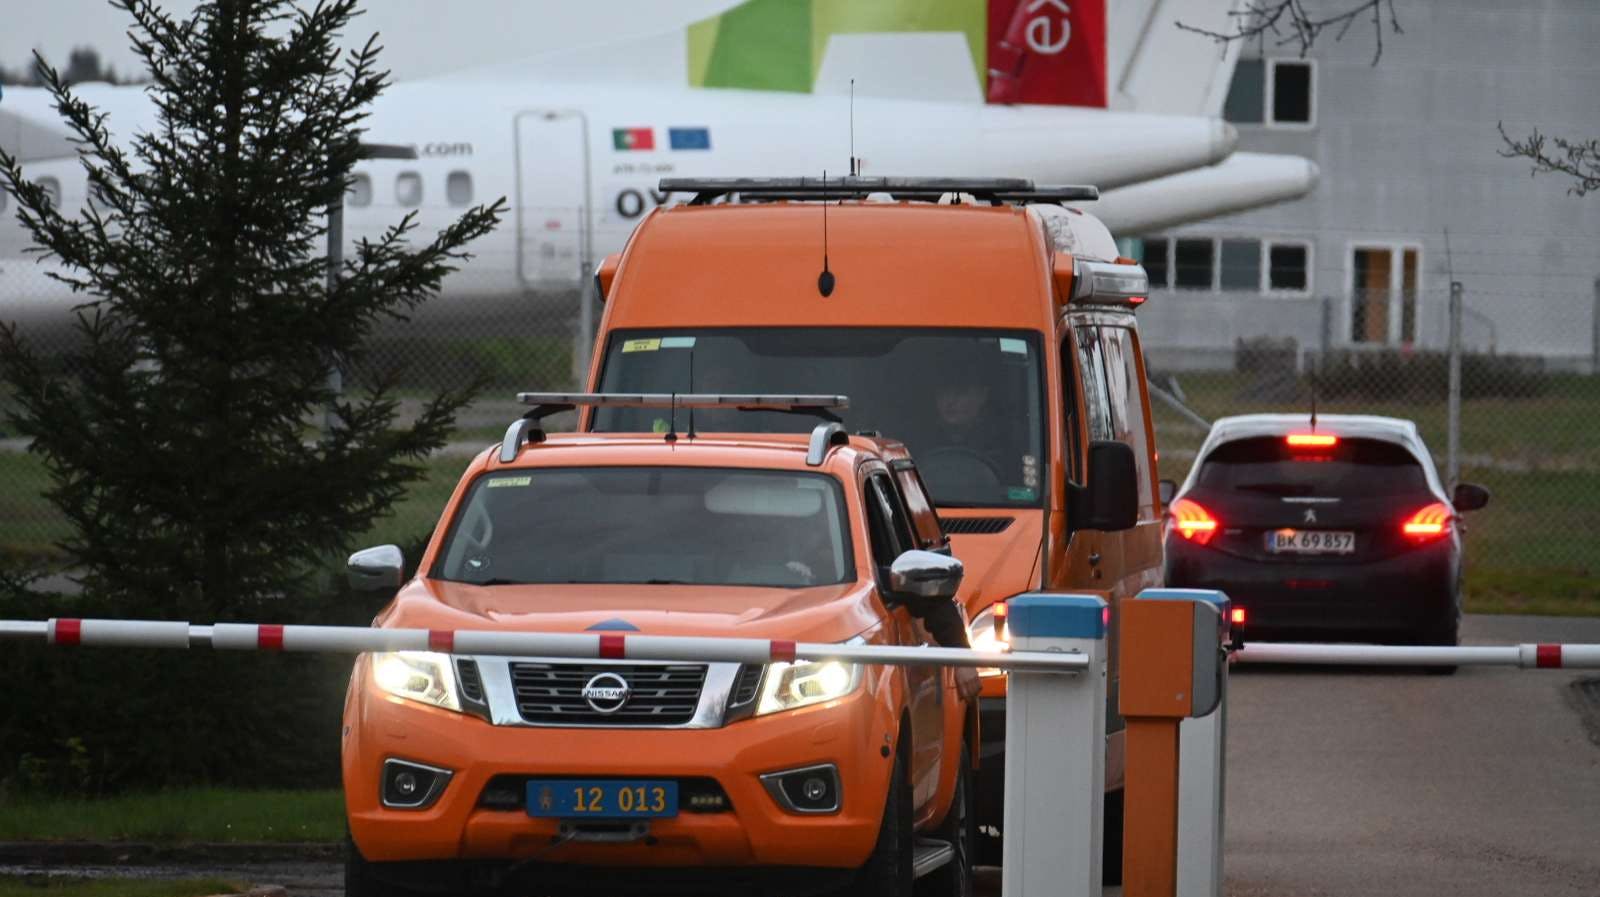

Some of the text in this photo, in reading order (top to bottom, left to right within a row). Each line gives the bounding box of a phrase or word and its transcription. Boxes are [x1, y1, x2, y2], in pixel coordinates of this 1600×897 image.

[1277, 533, 1352, 549] BK 69 857
[584, 688, 628, 699] NISSAN
[573, 787, 666, 812] 12 013
